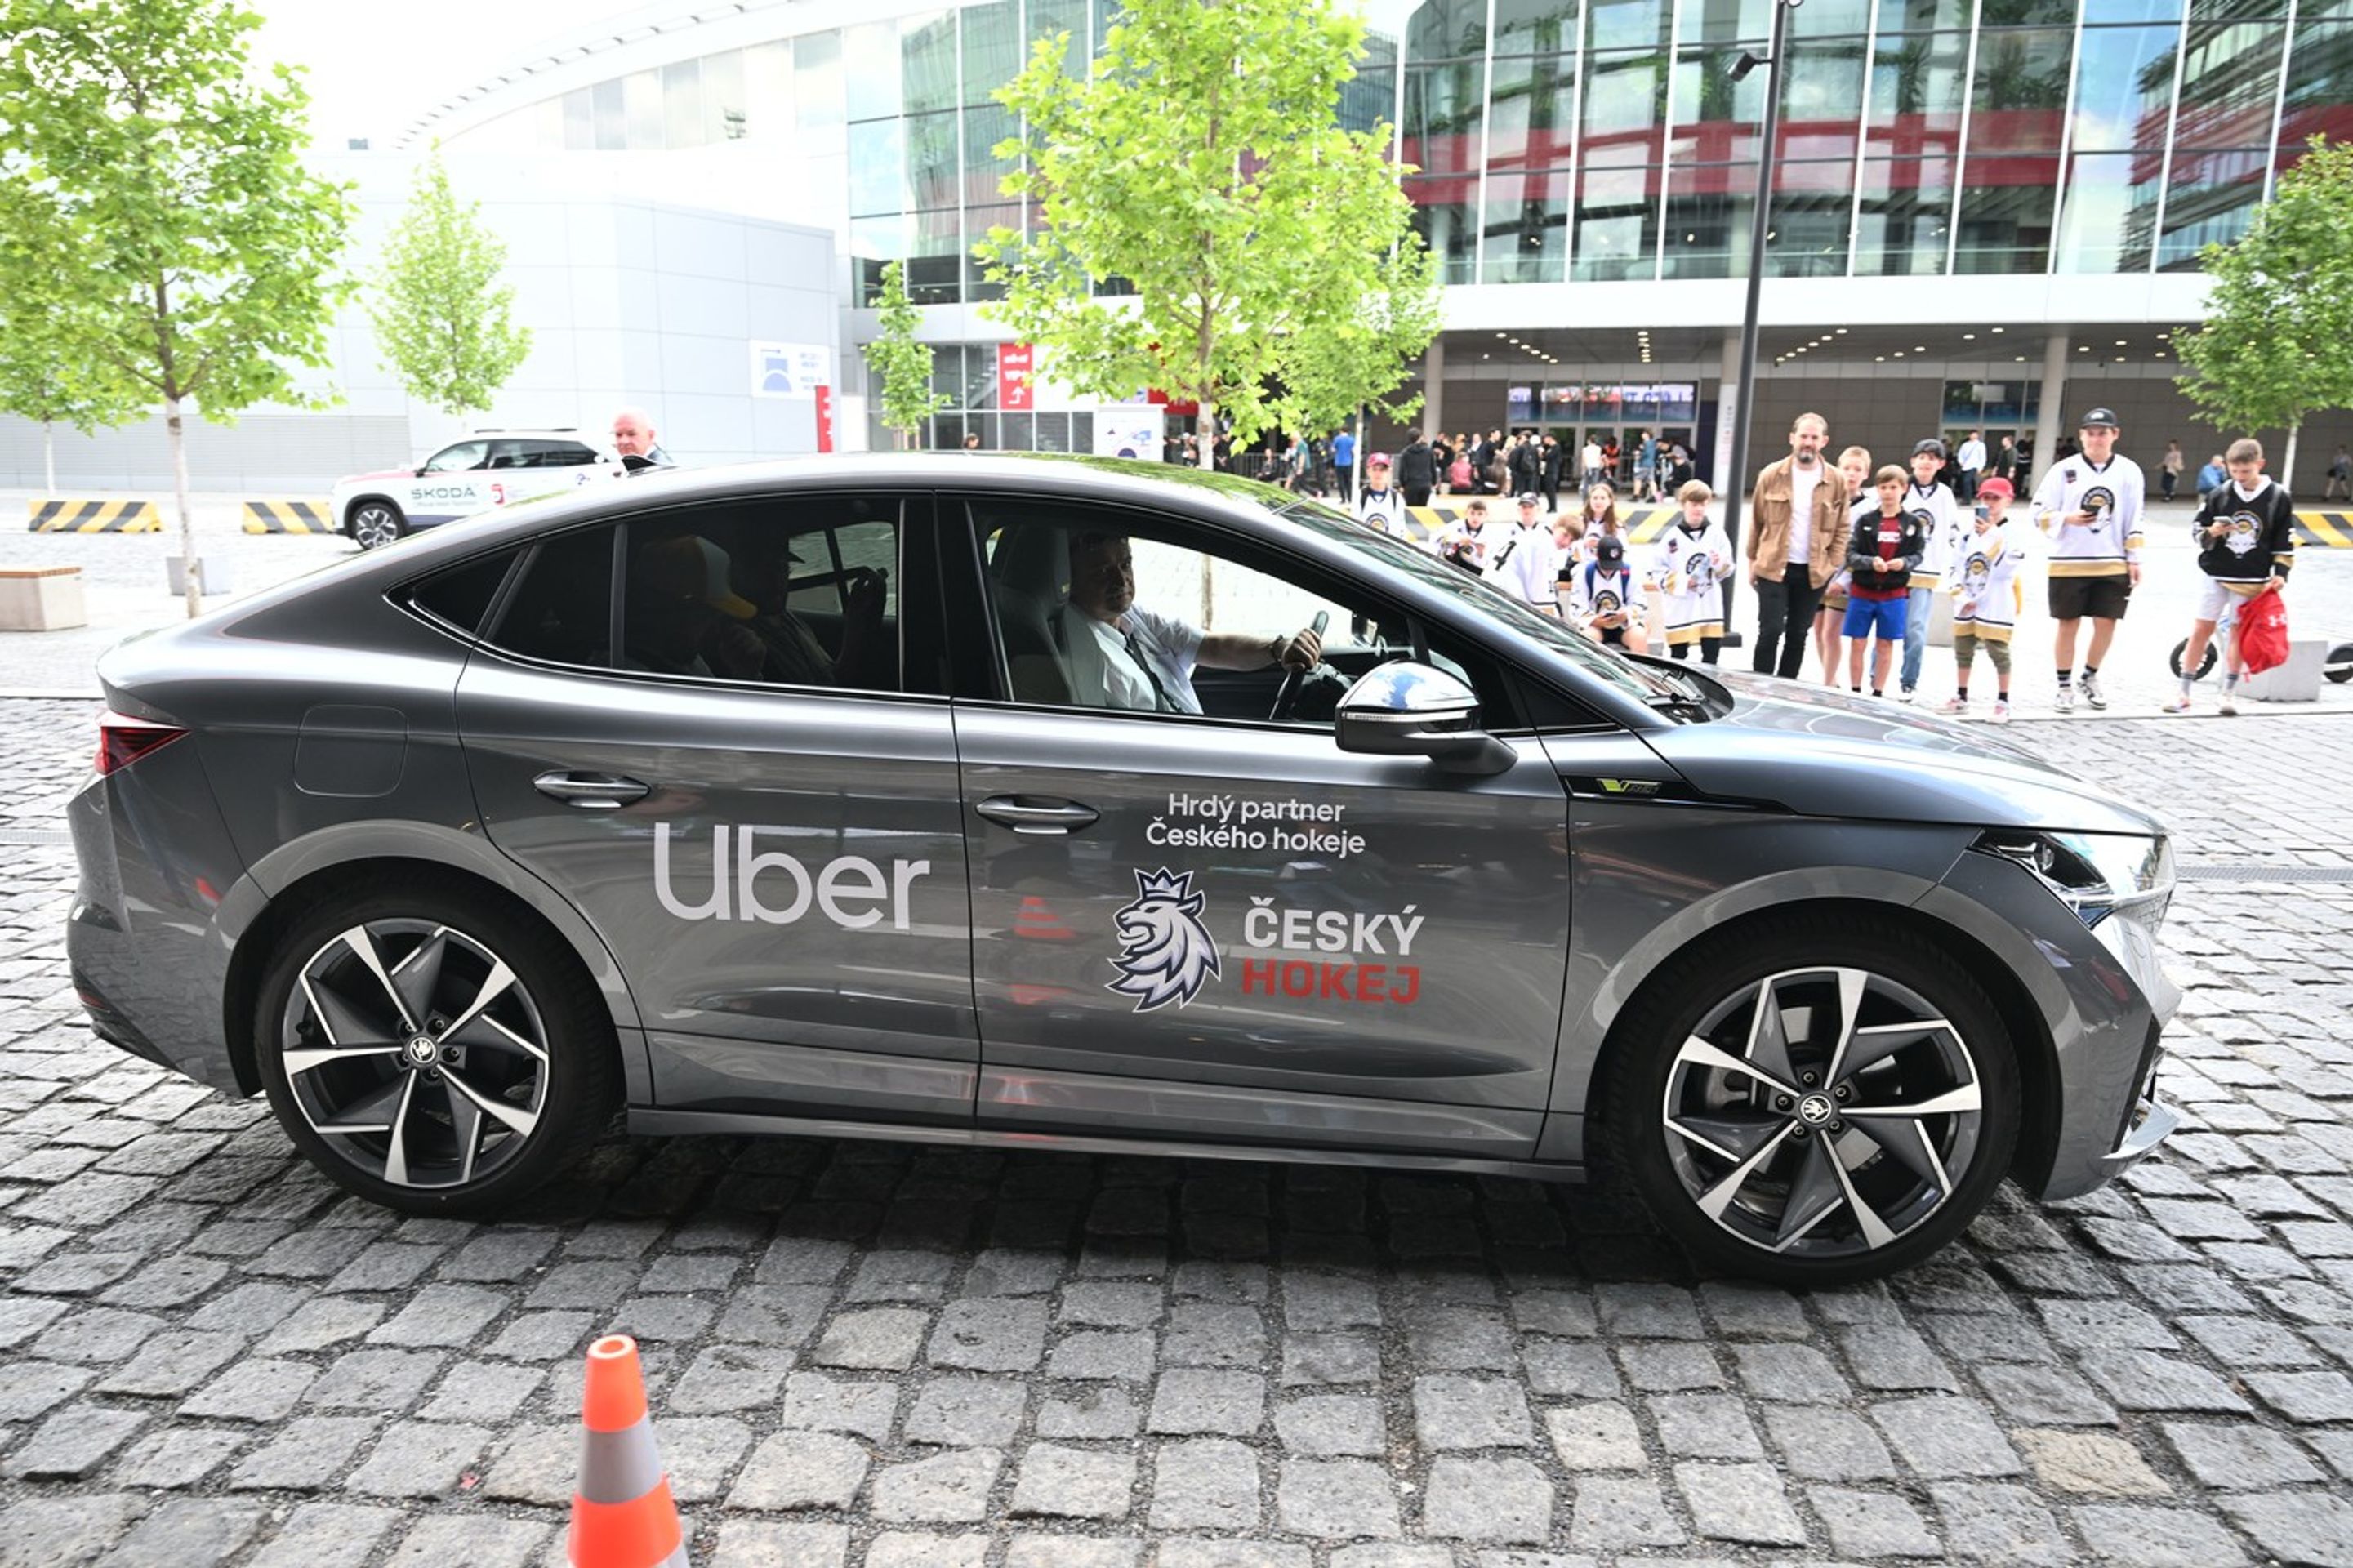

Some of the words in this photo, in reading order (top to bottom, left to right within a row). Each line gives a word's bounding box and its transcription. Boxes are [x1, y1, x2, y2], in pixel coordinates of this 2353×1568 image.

[1168, 792, 1235, 823] Hrdý
[1241, 798, 1346, 825] partner
[1145, 816, 1267, 849] Českého
[1272, 826, 1366, 858] hokeje
[653, 822, 931, 930] Uber
[1244, 895, 1425, 956] ČESKÝ
[1241, 956, 1421, 1005] HOKEJ
